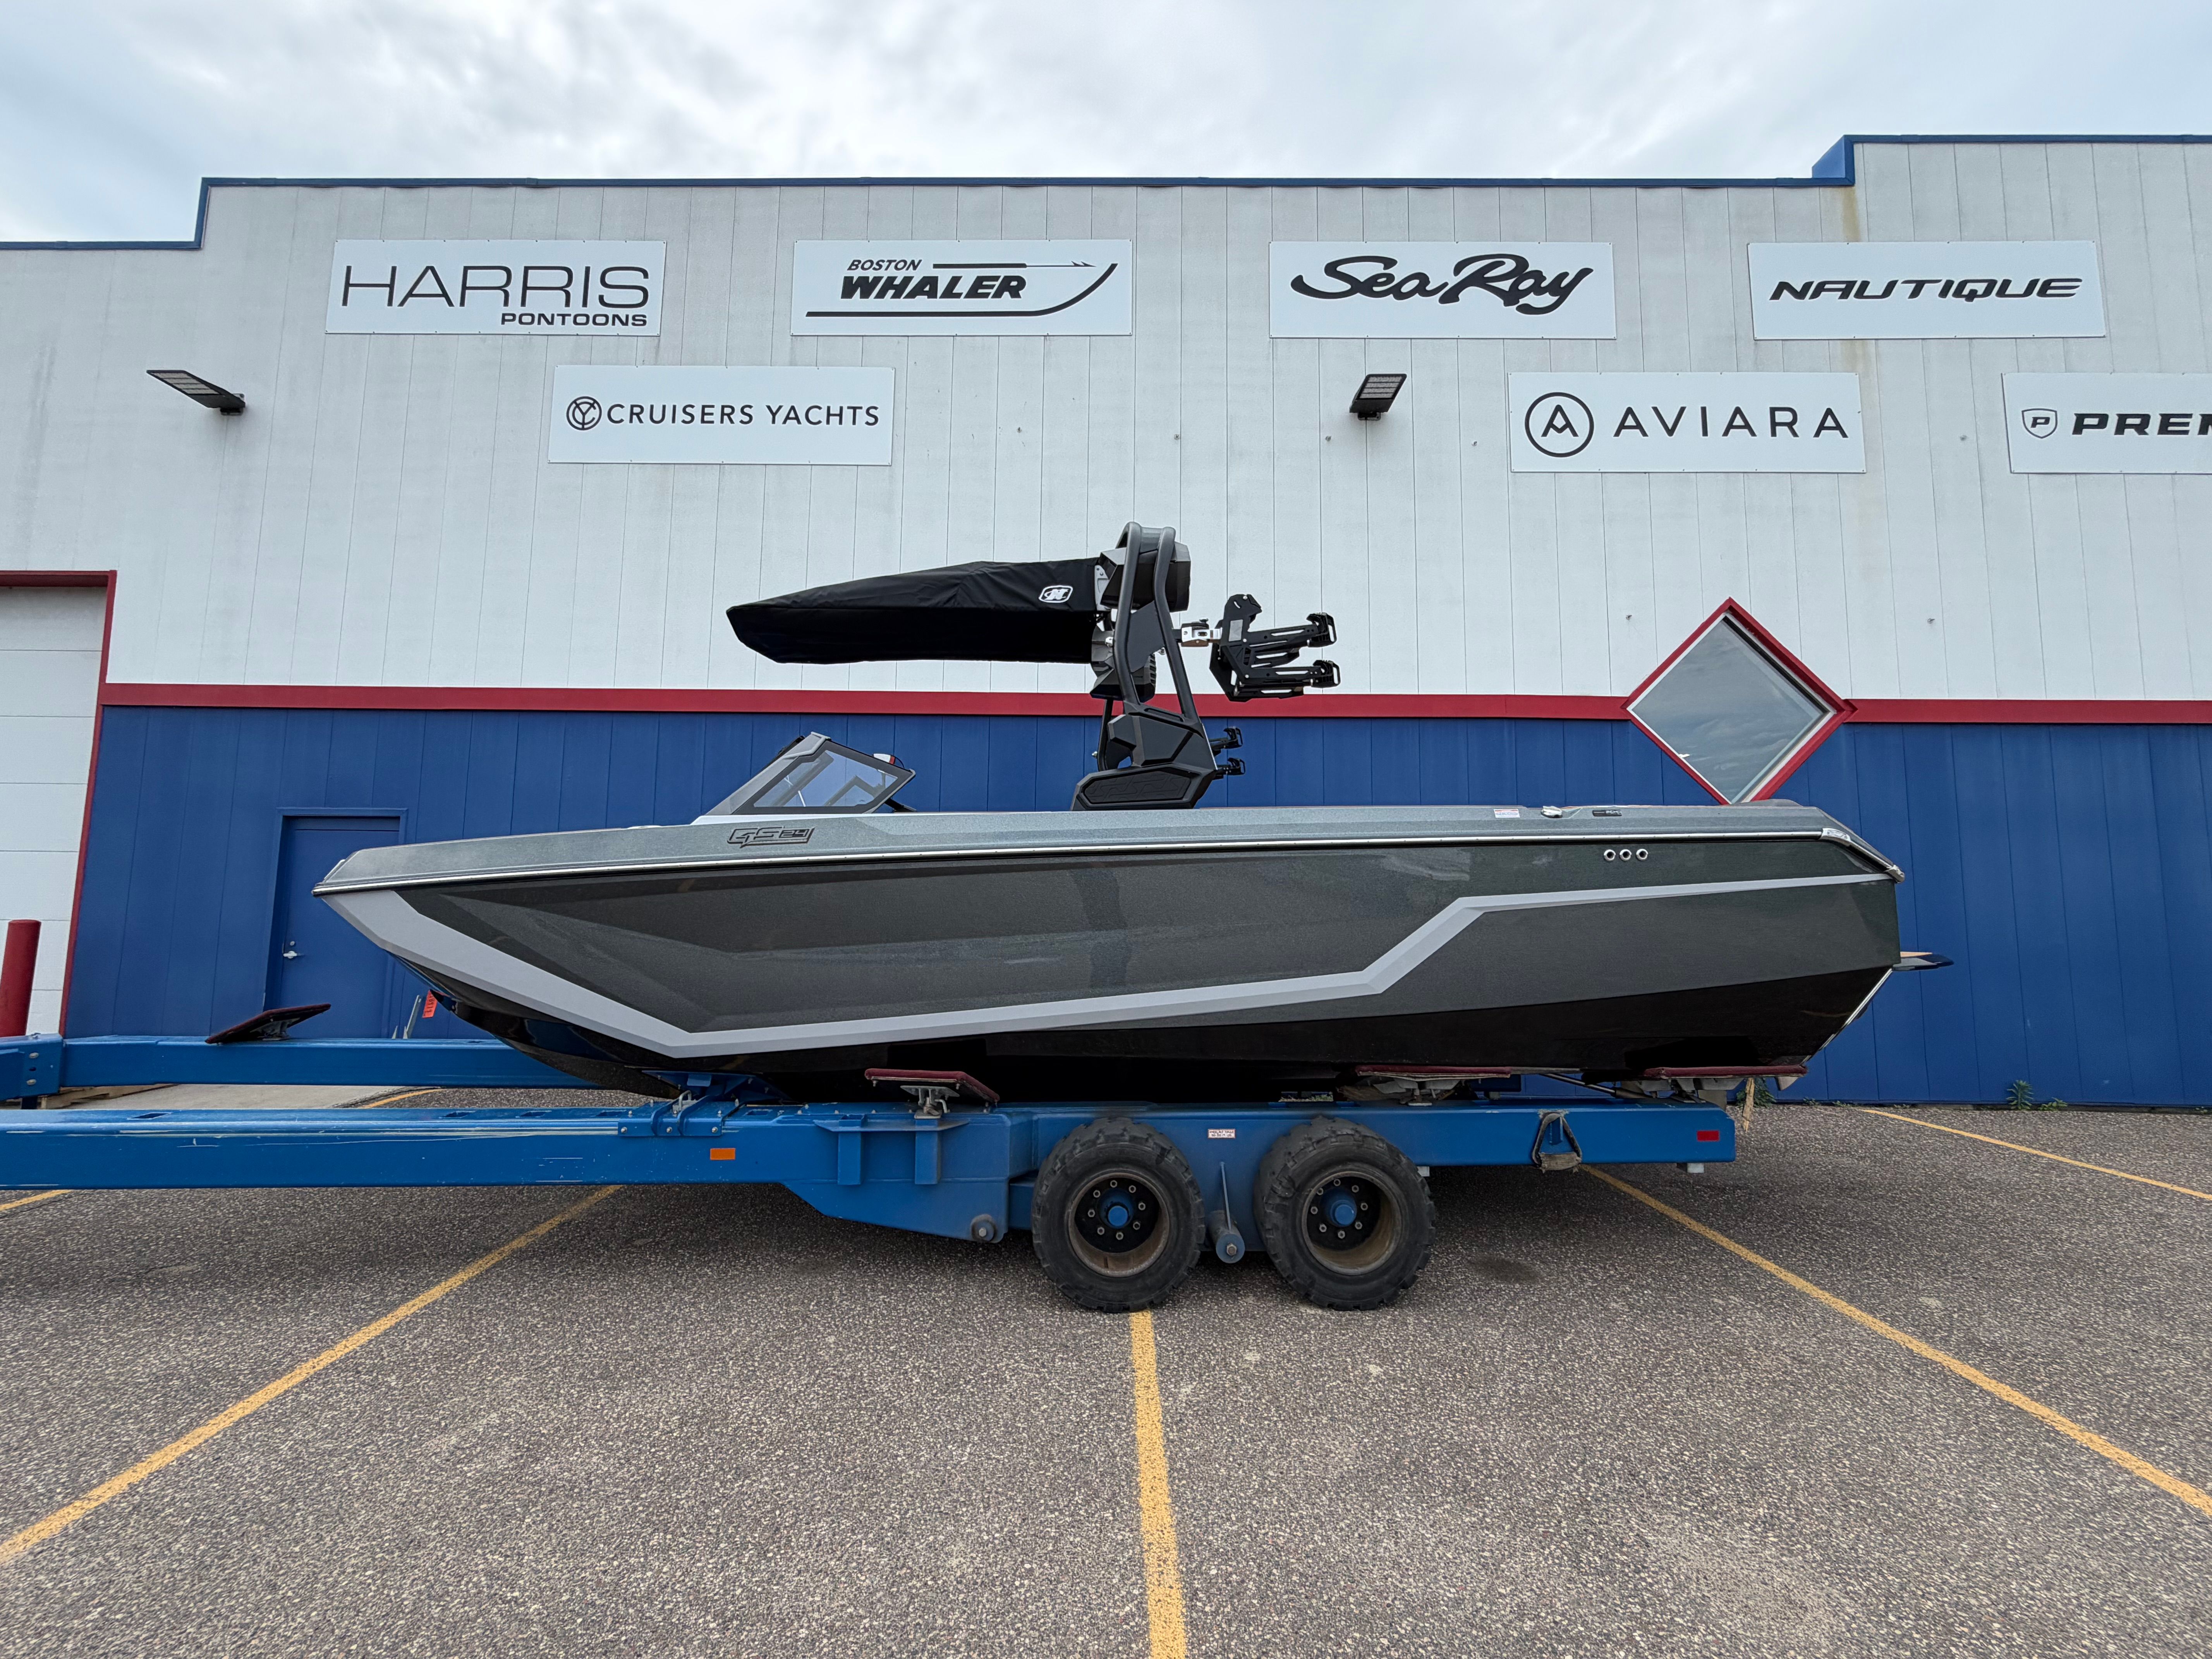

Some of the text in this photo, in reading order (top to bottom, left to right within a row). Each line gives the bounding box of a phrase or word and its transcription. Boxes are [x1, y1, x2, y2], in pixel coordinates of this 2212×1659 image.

[847, 259, 922, 271] BOSTON
[342, 265, 649, 309] HARRIS
[840, 275, 1027, 299] WHALER
[1290, 253, 1594, 315] Sea Ray
[1769, 278, 2083, 302] NAUTIQUE
[501, 313, 647, 327] PONTOONS
[607, 404, 754, 425] CRUISERS
[765, 405, 879, 426] YACHTS
[1613, 406, 1848, 438] AVIARA
